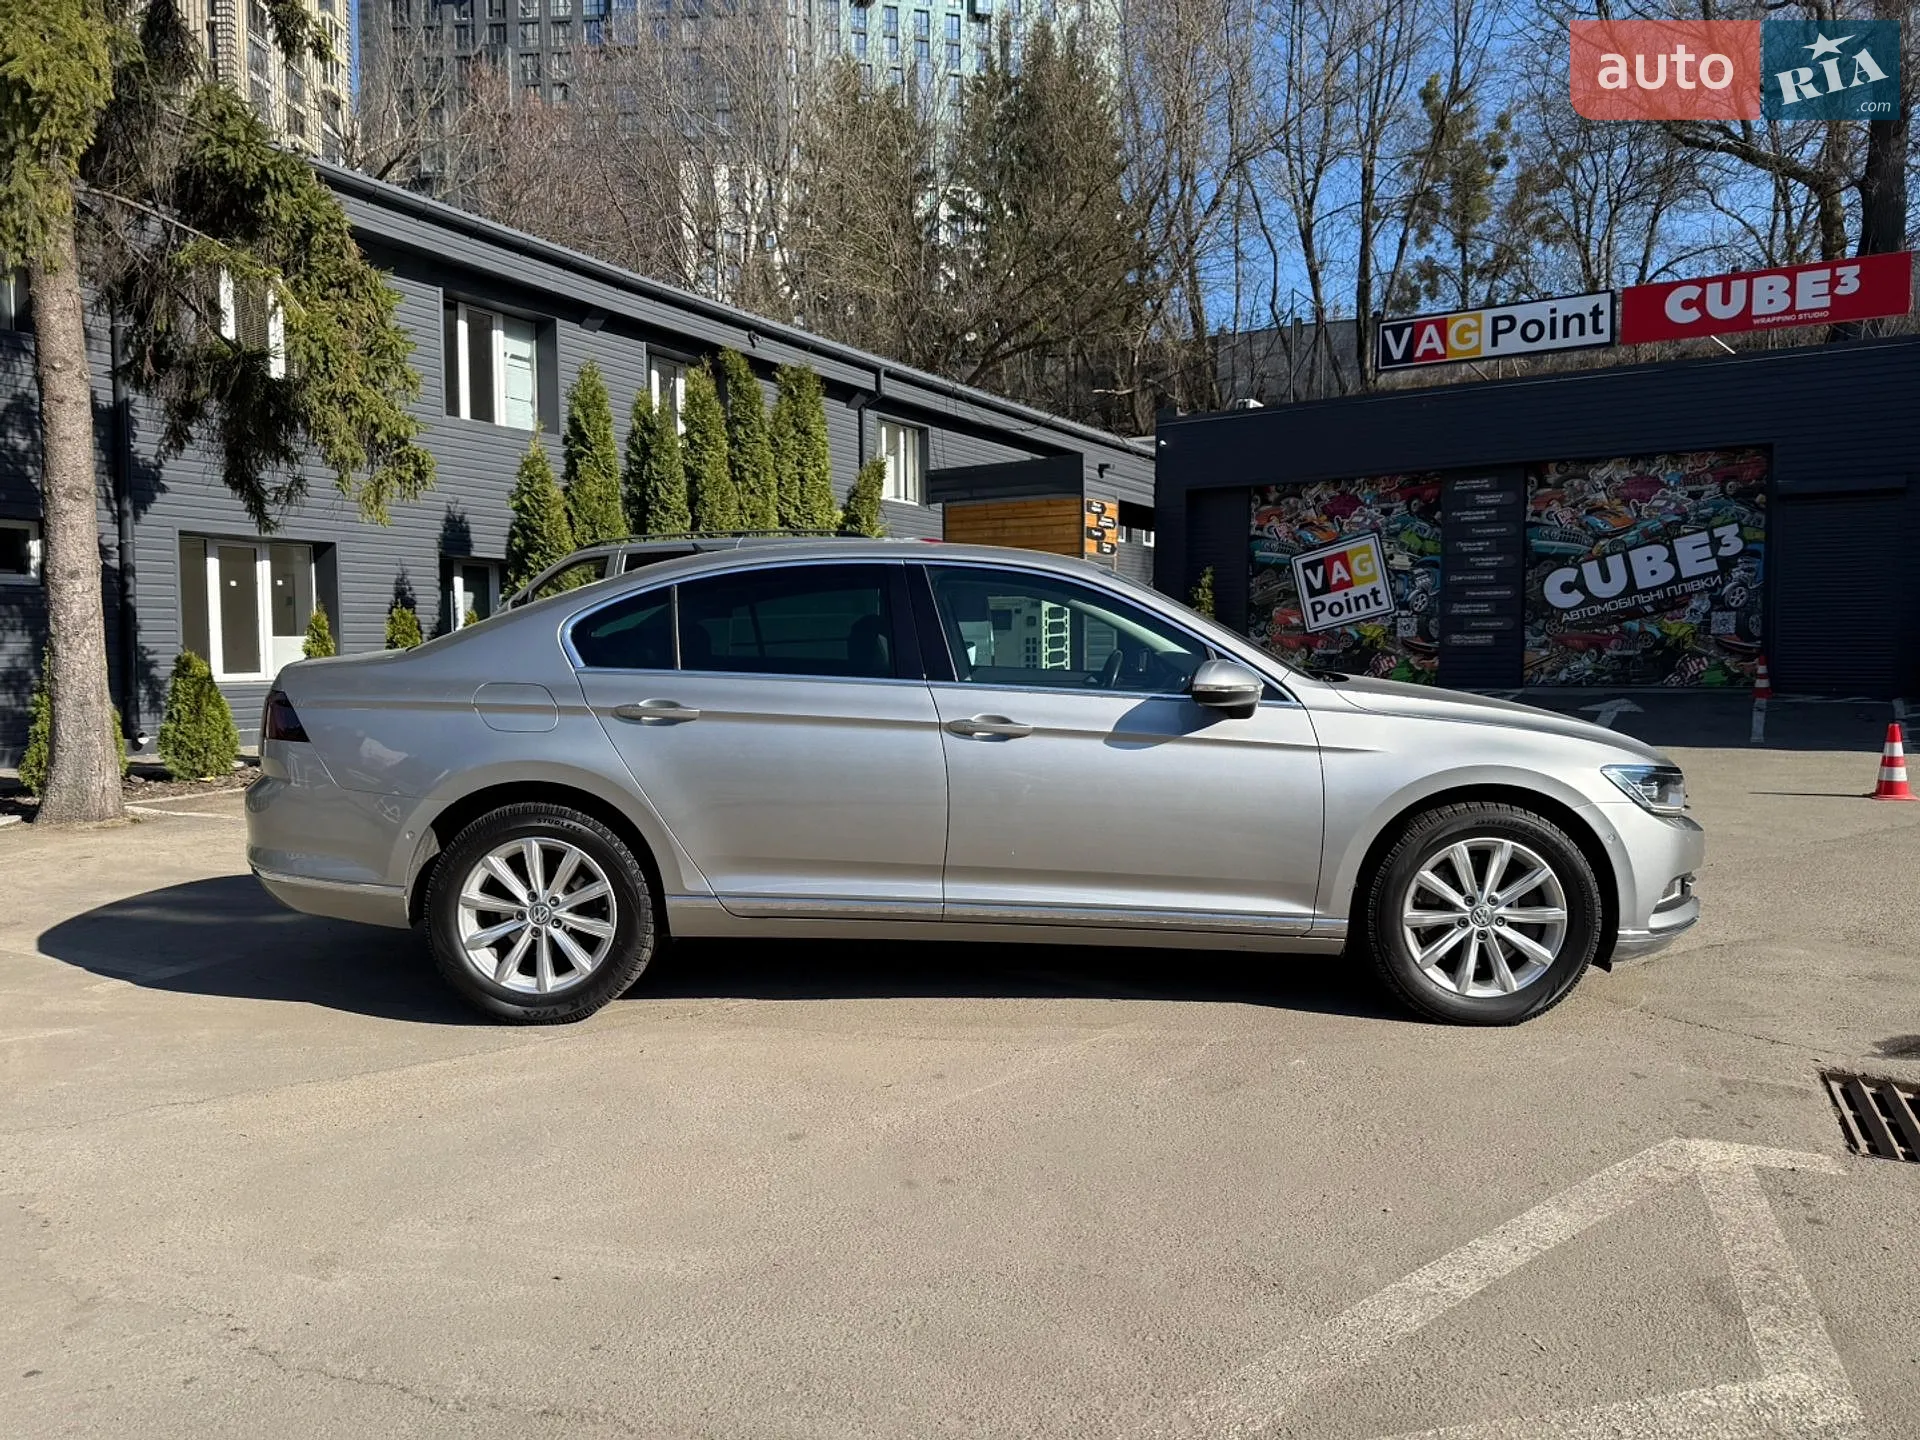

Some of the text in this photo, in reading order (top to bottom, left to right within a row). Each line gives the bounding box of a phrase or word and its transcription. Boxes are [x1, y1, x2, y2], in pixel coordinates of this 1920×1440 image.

[1384, 302, 1605, 361] VAG Point
[1752, 310, 1830, 325] WRAPPING STUDIO
[1305, 553, 1375, 590] VAG
[1310, 587, 1384, 623] Point
[1561, 574, 1723, 623] АВТОМОБІЛЬНІ ПЛІВКИ
